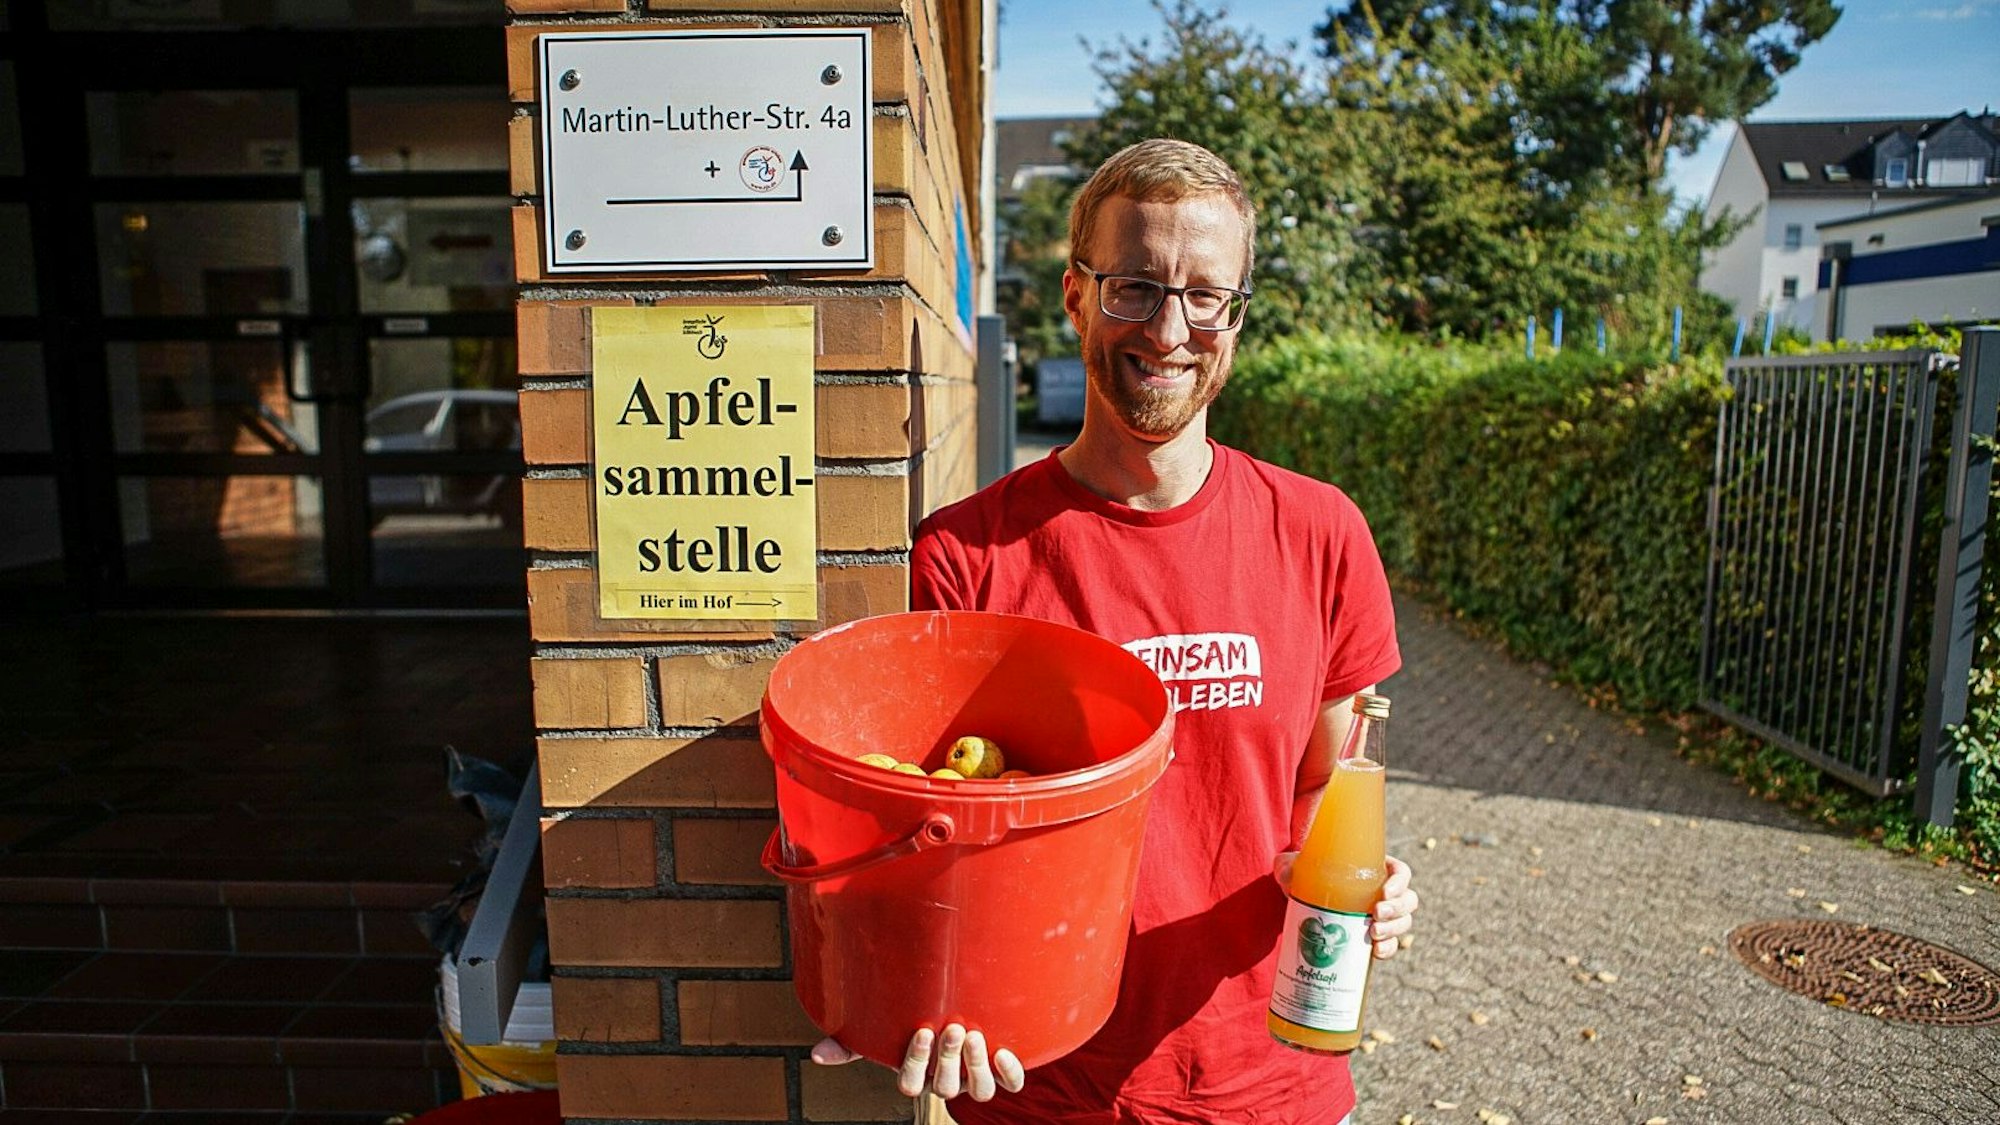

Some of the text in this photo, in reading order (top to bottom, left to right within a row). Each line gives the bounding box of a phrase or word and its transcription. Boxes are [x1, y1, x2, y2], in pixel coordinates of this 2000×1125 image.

[563, 103, 851, 133] Martin-Luther-Str. 4a
[616, 377, 797, 440] Apfel-
[604, 455, 814, 497] sammel-
[638, 525, 782, 574] stelle
[640, 594, 733, 609] Hier im Hof
[1131, 640, 1247, 674] EINSAM
